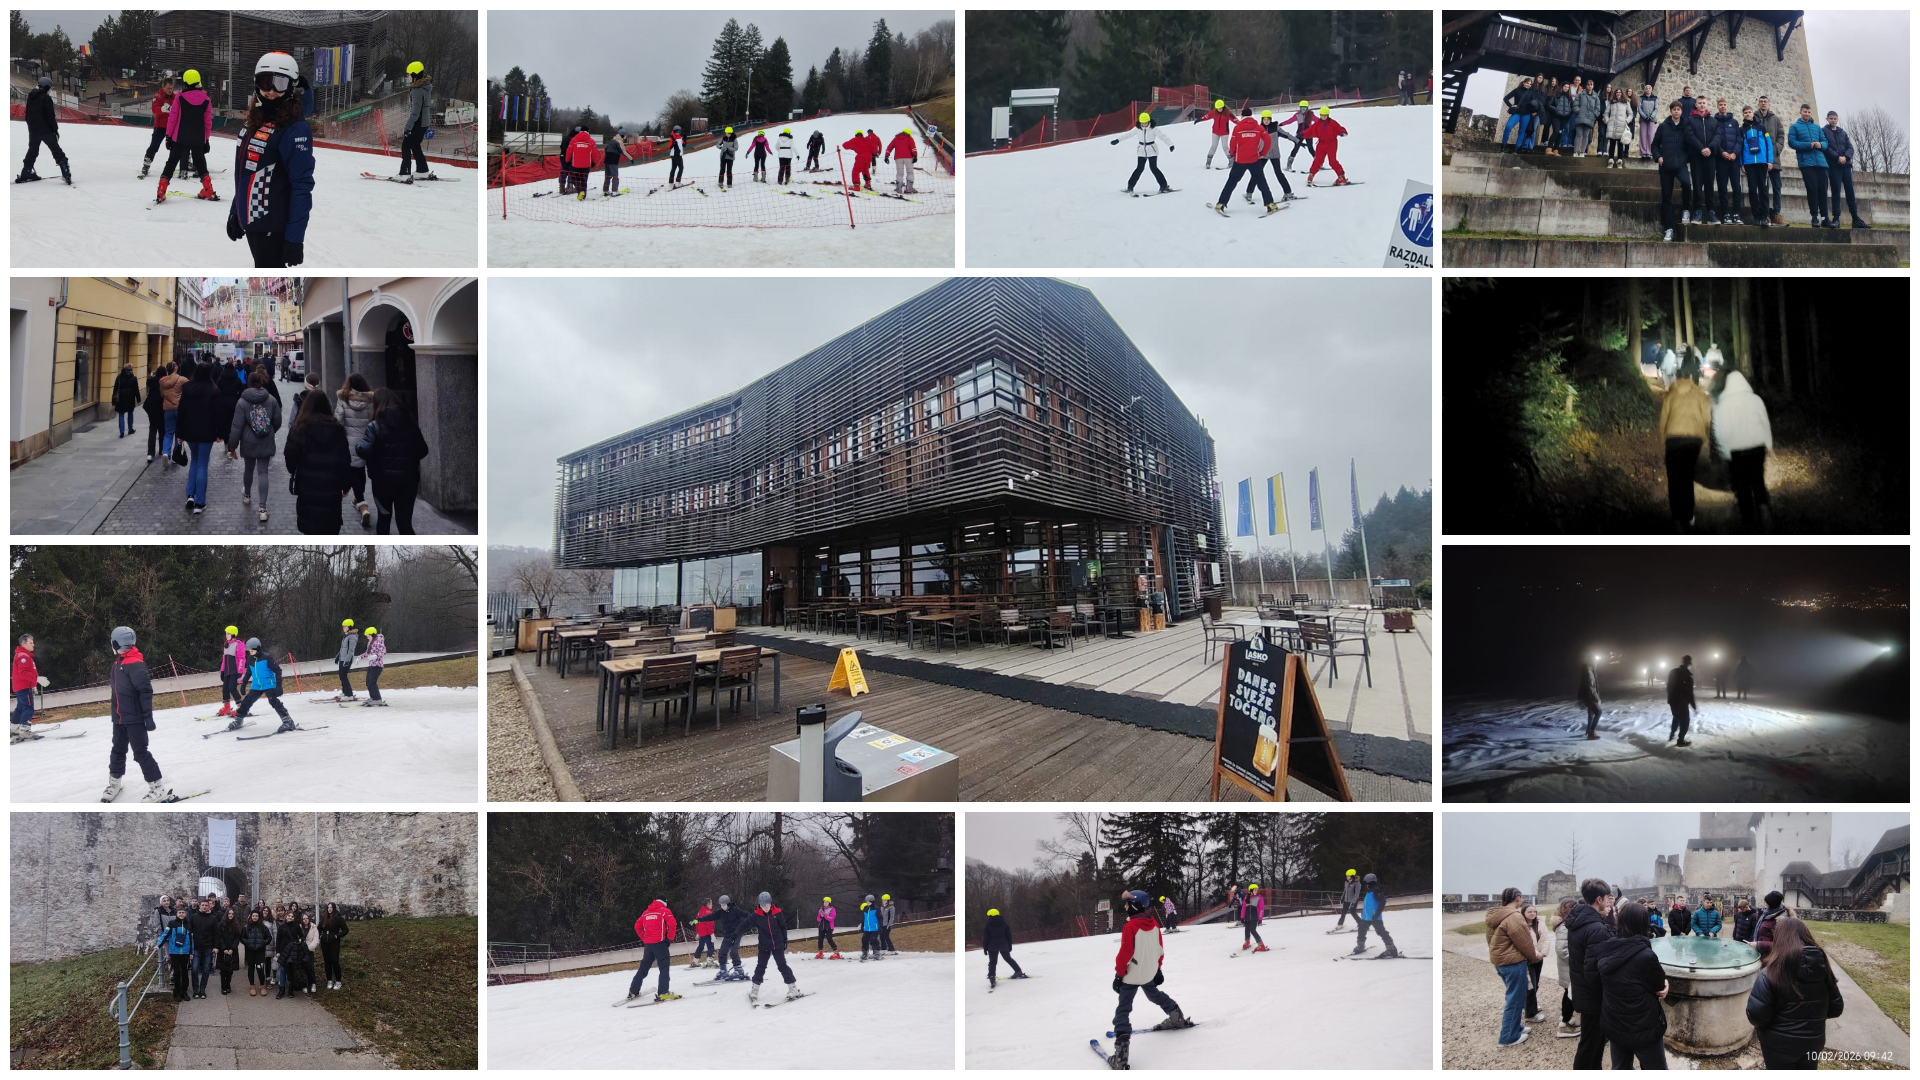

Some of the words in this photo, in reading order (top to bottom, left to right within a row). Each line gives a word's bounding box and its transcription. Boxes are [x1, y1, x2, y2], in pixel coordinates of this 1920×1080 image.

[1389, 245, 1433, 268] RAZDAL
[1245, 649, 1268, 661] LAŠKO
[1237, 667, 1277, 695] DANES
[1229, 693, 1277, 729] TOČENO
[1236, 683, 1274, 712] SVEŽE
